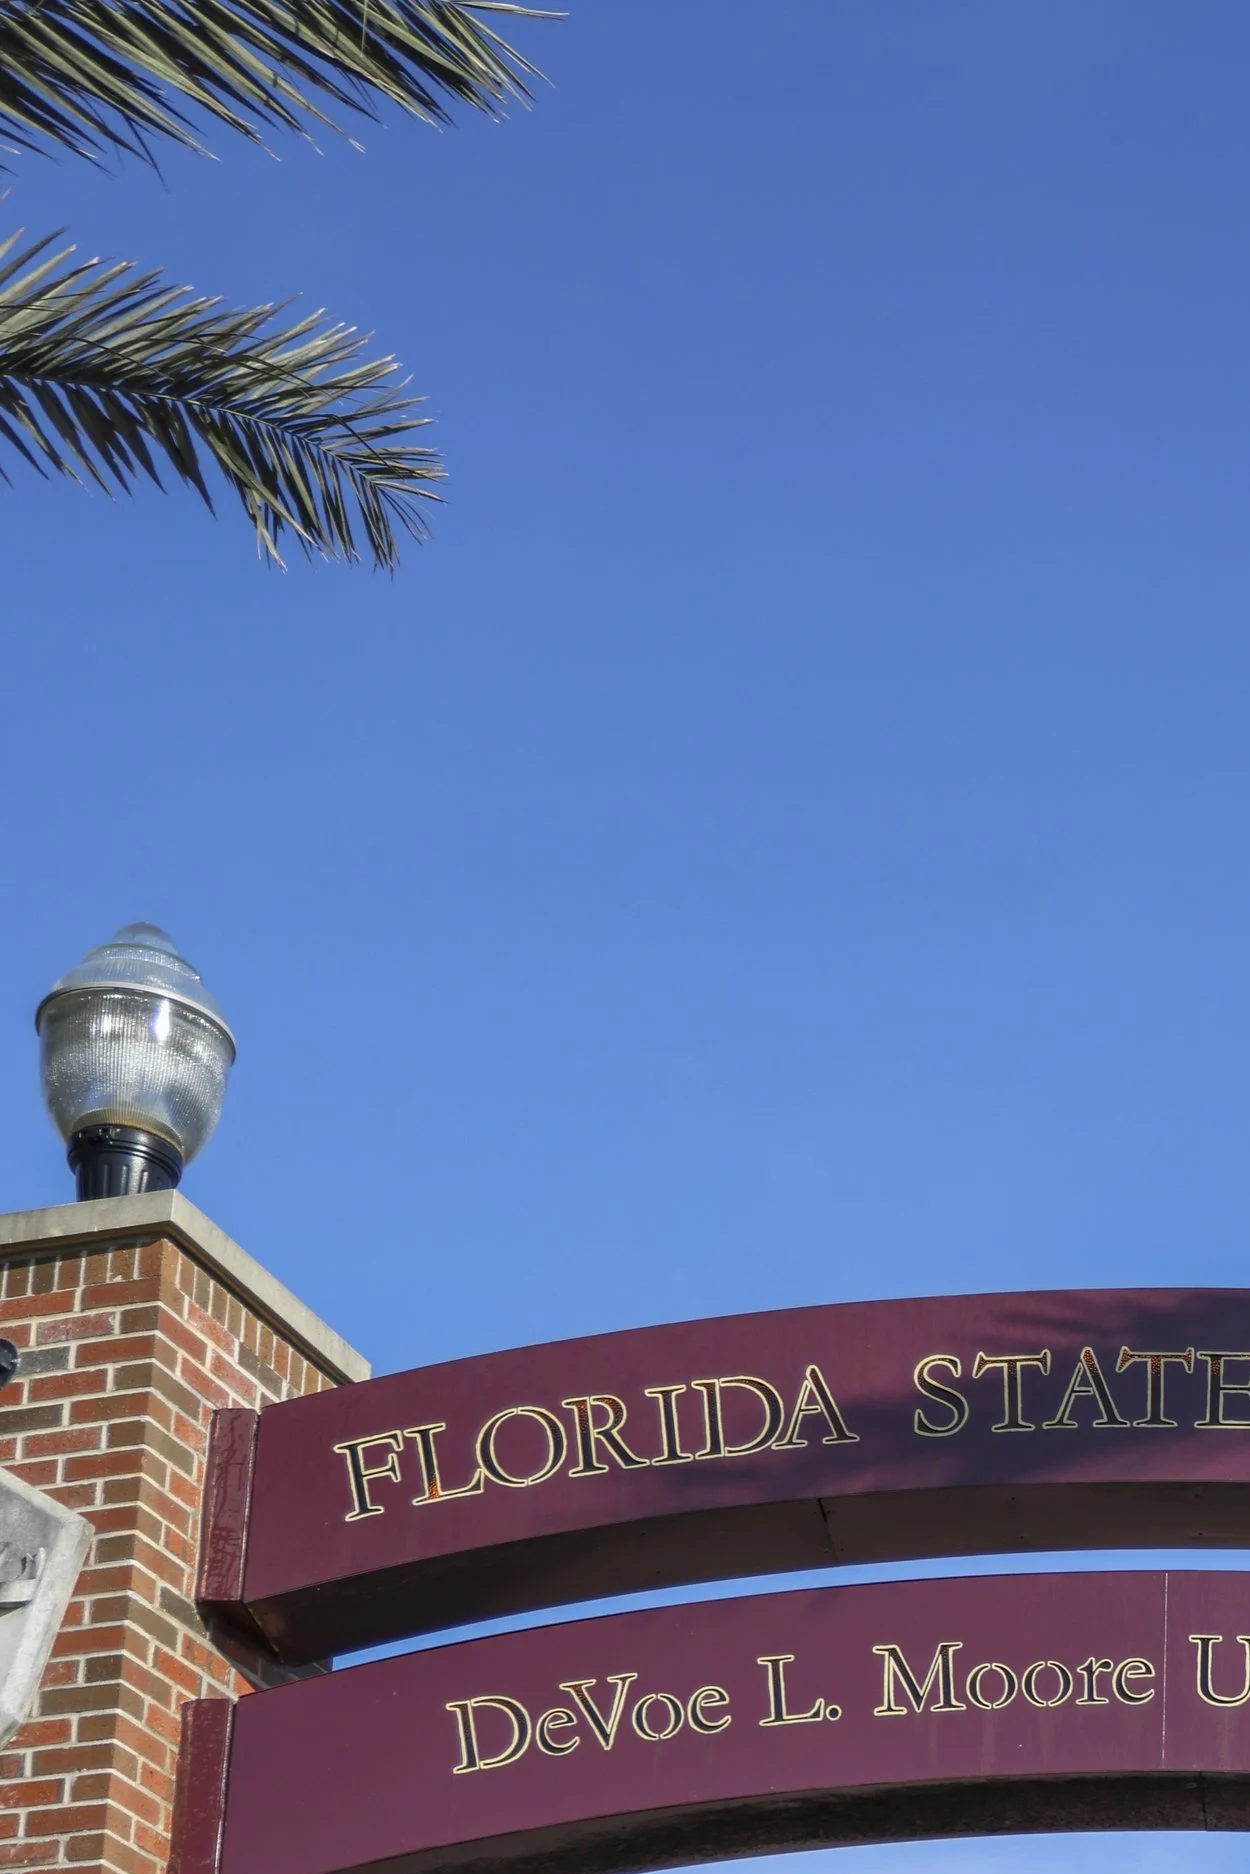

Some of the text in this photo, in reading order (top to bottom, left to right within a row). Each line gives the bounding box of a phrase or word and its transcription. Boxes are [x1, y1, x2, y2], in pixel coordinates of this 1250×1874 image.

[334, 1364, 860, 1523] FLORIDA
[445, 1672, 732, 1775] DeVoe
[757, 1654, 841, 1728] L.
[873, 1641, 1156, 1718] Moore
